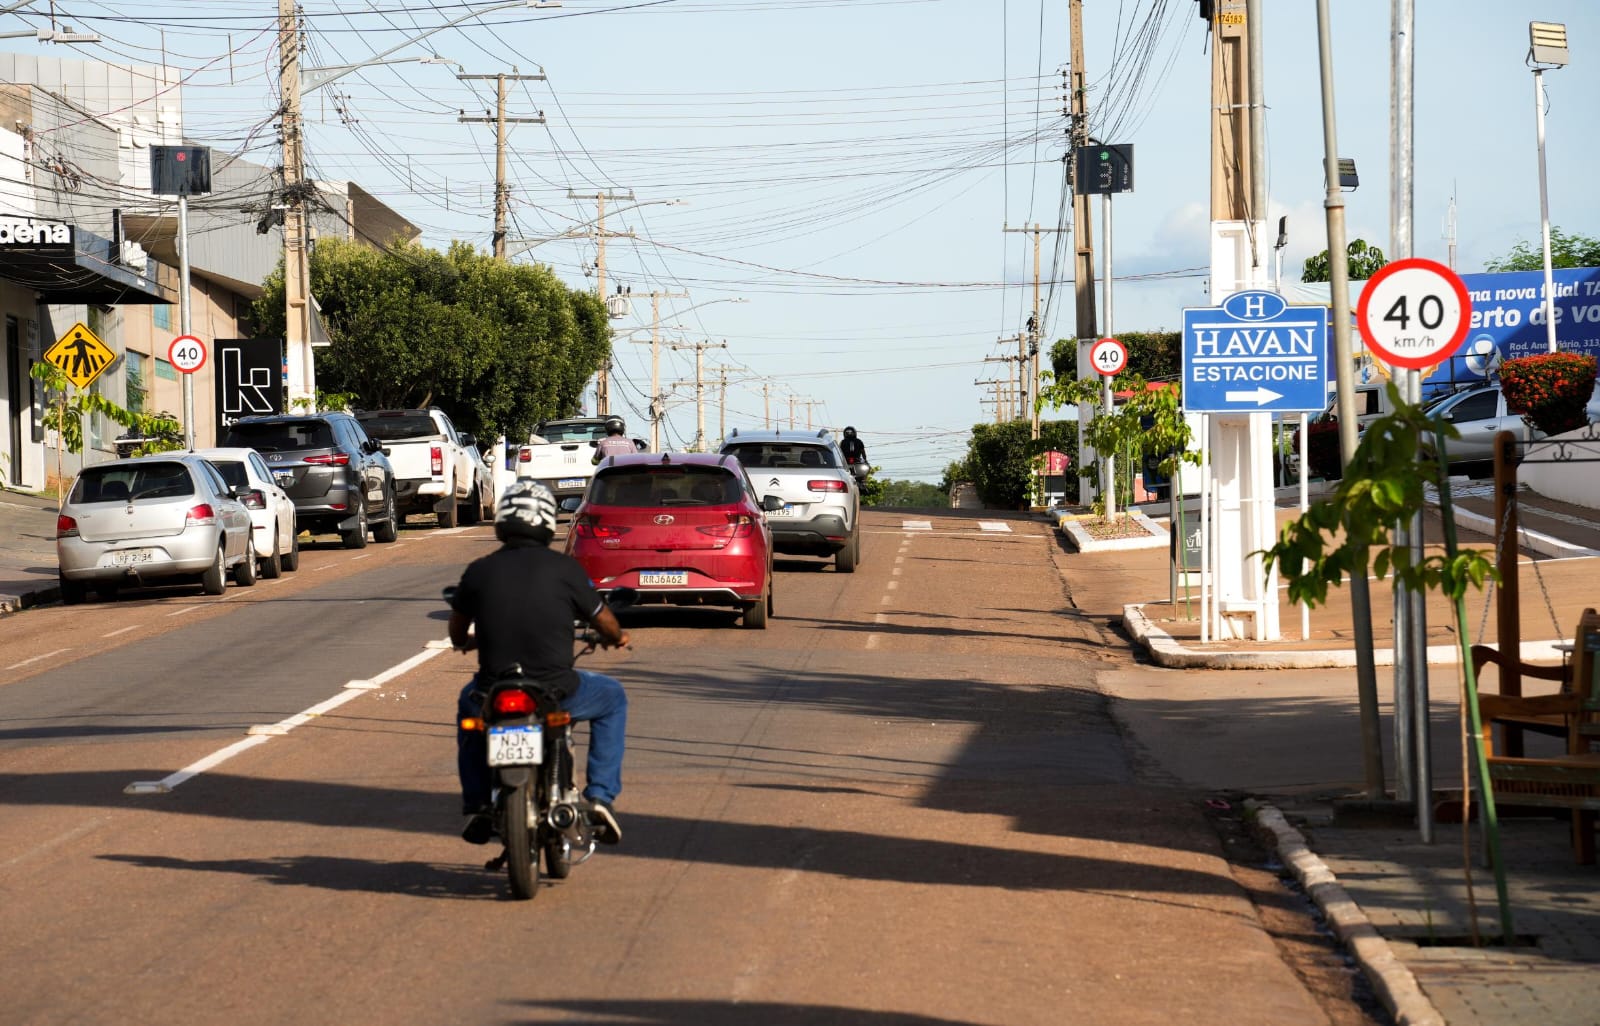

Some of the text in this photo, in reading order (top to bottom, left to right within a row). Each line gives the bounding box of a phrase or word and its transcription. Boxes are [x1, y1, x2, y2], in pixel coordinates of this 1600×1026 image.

[1495, 287, 1536, 301] nova
[1243, 296, 1266, 317] H
[1383, 294, 1444, 331] 40
[1193, 328, 1316, 356] HAVAN
[1394, 336, 1435, 348] km/h
[177, 347, 198, 360] 40
[1098, 350, 1119, 363] 40
[1193, 365, 1318, 382] ESTACIONE
[643, 575, 683, 584] RRJ6A62
[496, 746, 534, 761] 6G13
